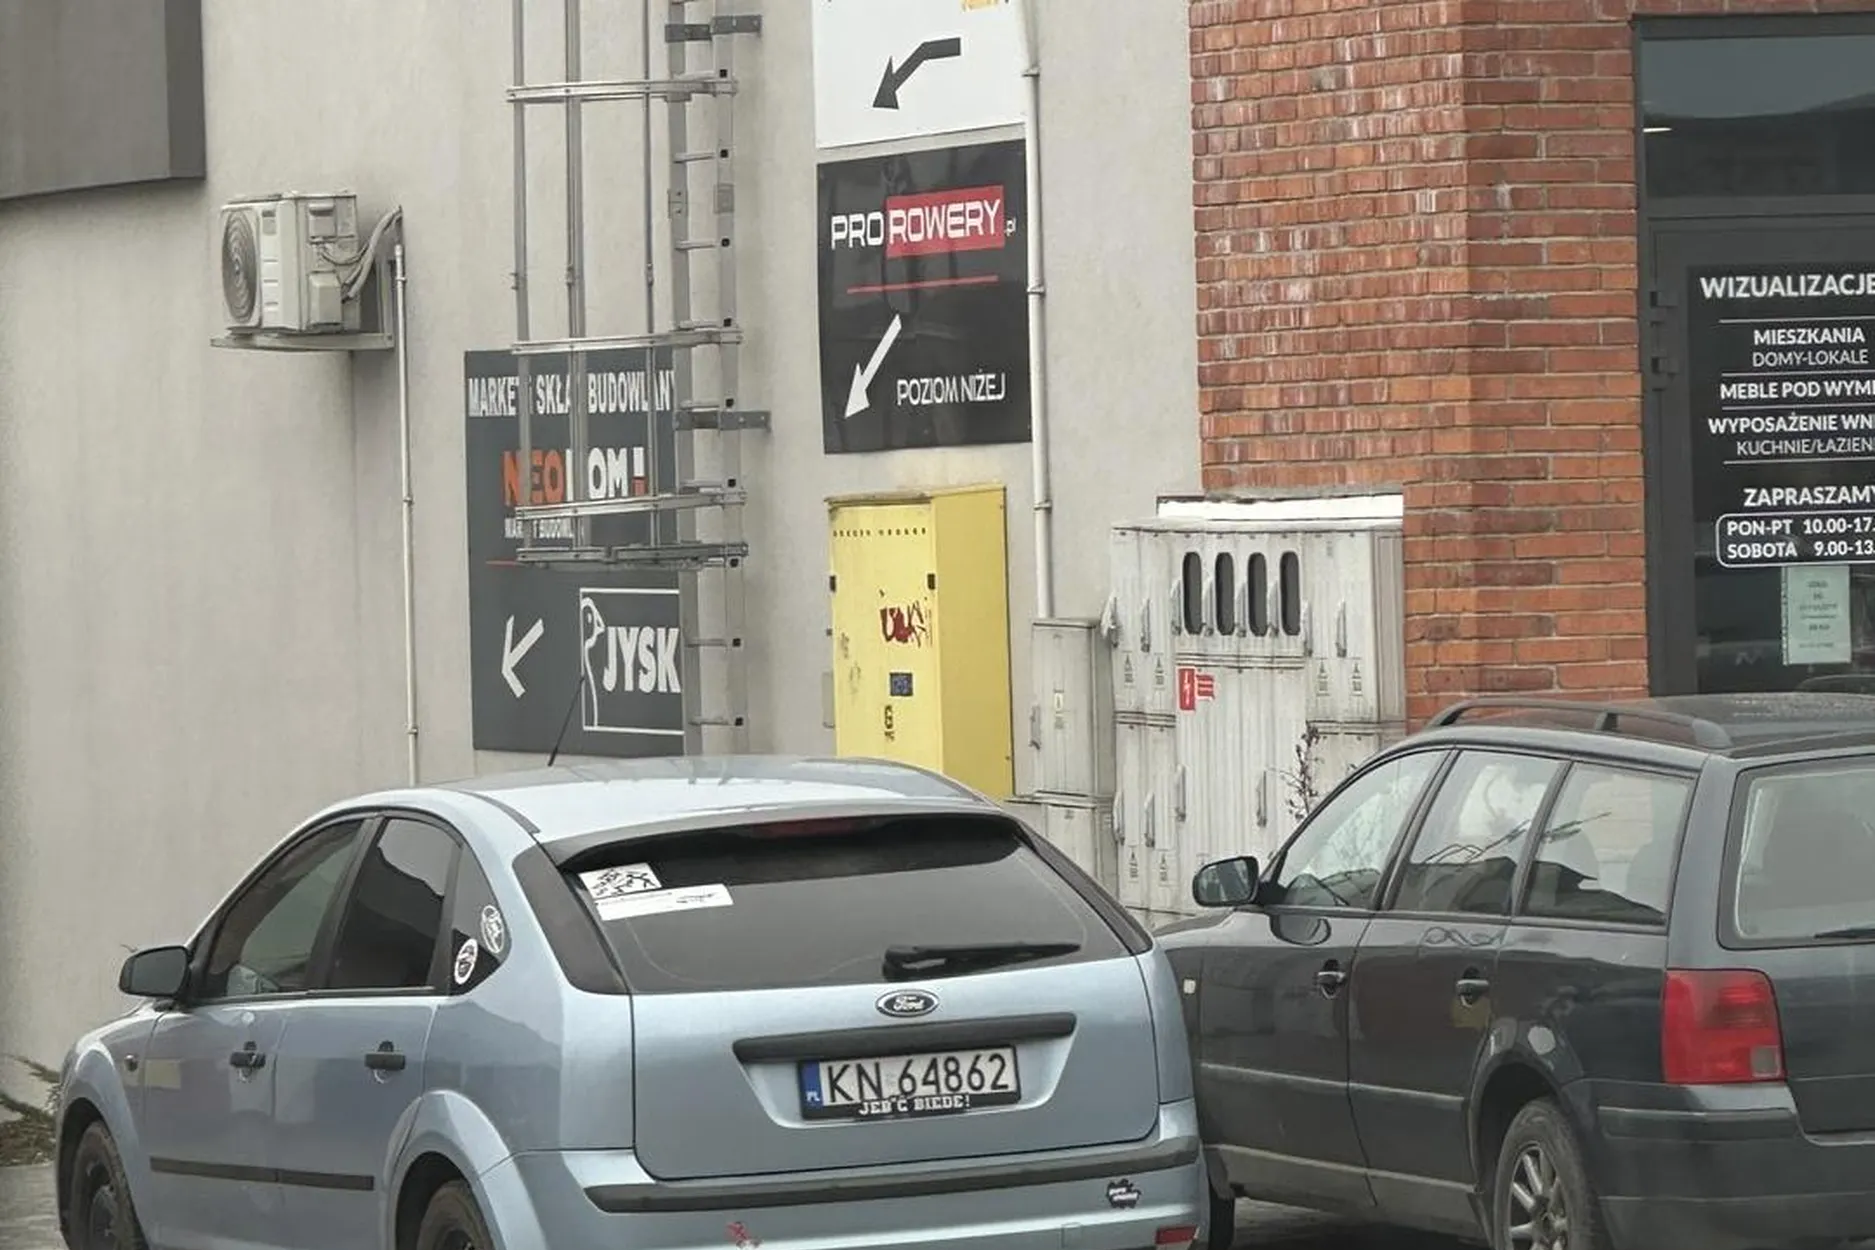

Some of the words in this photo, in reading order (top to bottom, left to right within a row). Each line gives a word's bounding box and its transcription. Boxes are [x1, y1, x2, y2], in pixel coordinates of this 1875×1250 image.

[831, 212, 884, 250] PRO
[889, 199, 1001, 245] ROWERY
[1754, 327, 1866, 346] MIESZKANIA
[1752, 349, 1869, 367] DOMY-LOKALE
[897, 374, 958, 406] POZIOM
[960, 368, 1006, 402] NIŻEJ
[1720, 383, 1779, 399] MEBLE
[1782, 381, 1821, 398] POD
[1708, 412, 1838, 434] WYPOSAŻENIE
[1727, 519, 1793, 536] PON-PT
[1727, 542, 1798, 559] SOBOTA
[603, 626, 681, 693] JYSK
[827, 1062, 885, 1103] KN
[898, 1053, 1009, 1097] 64862
